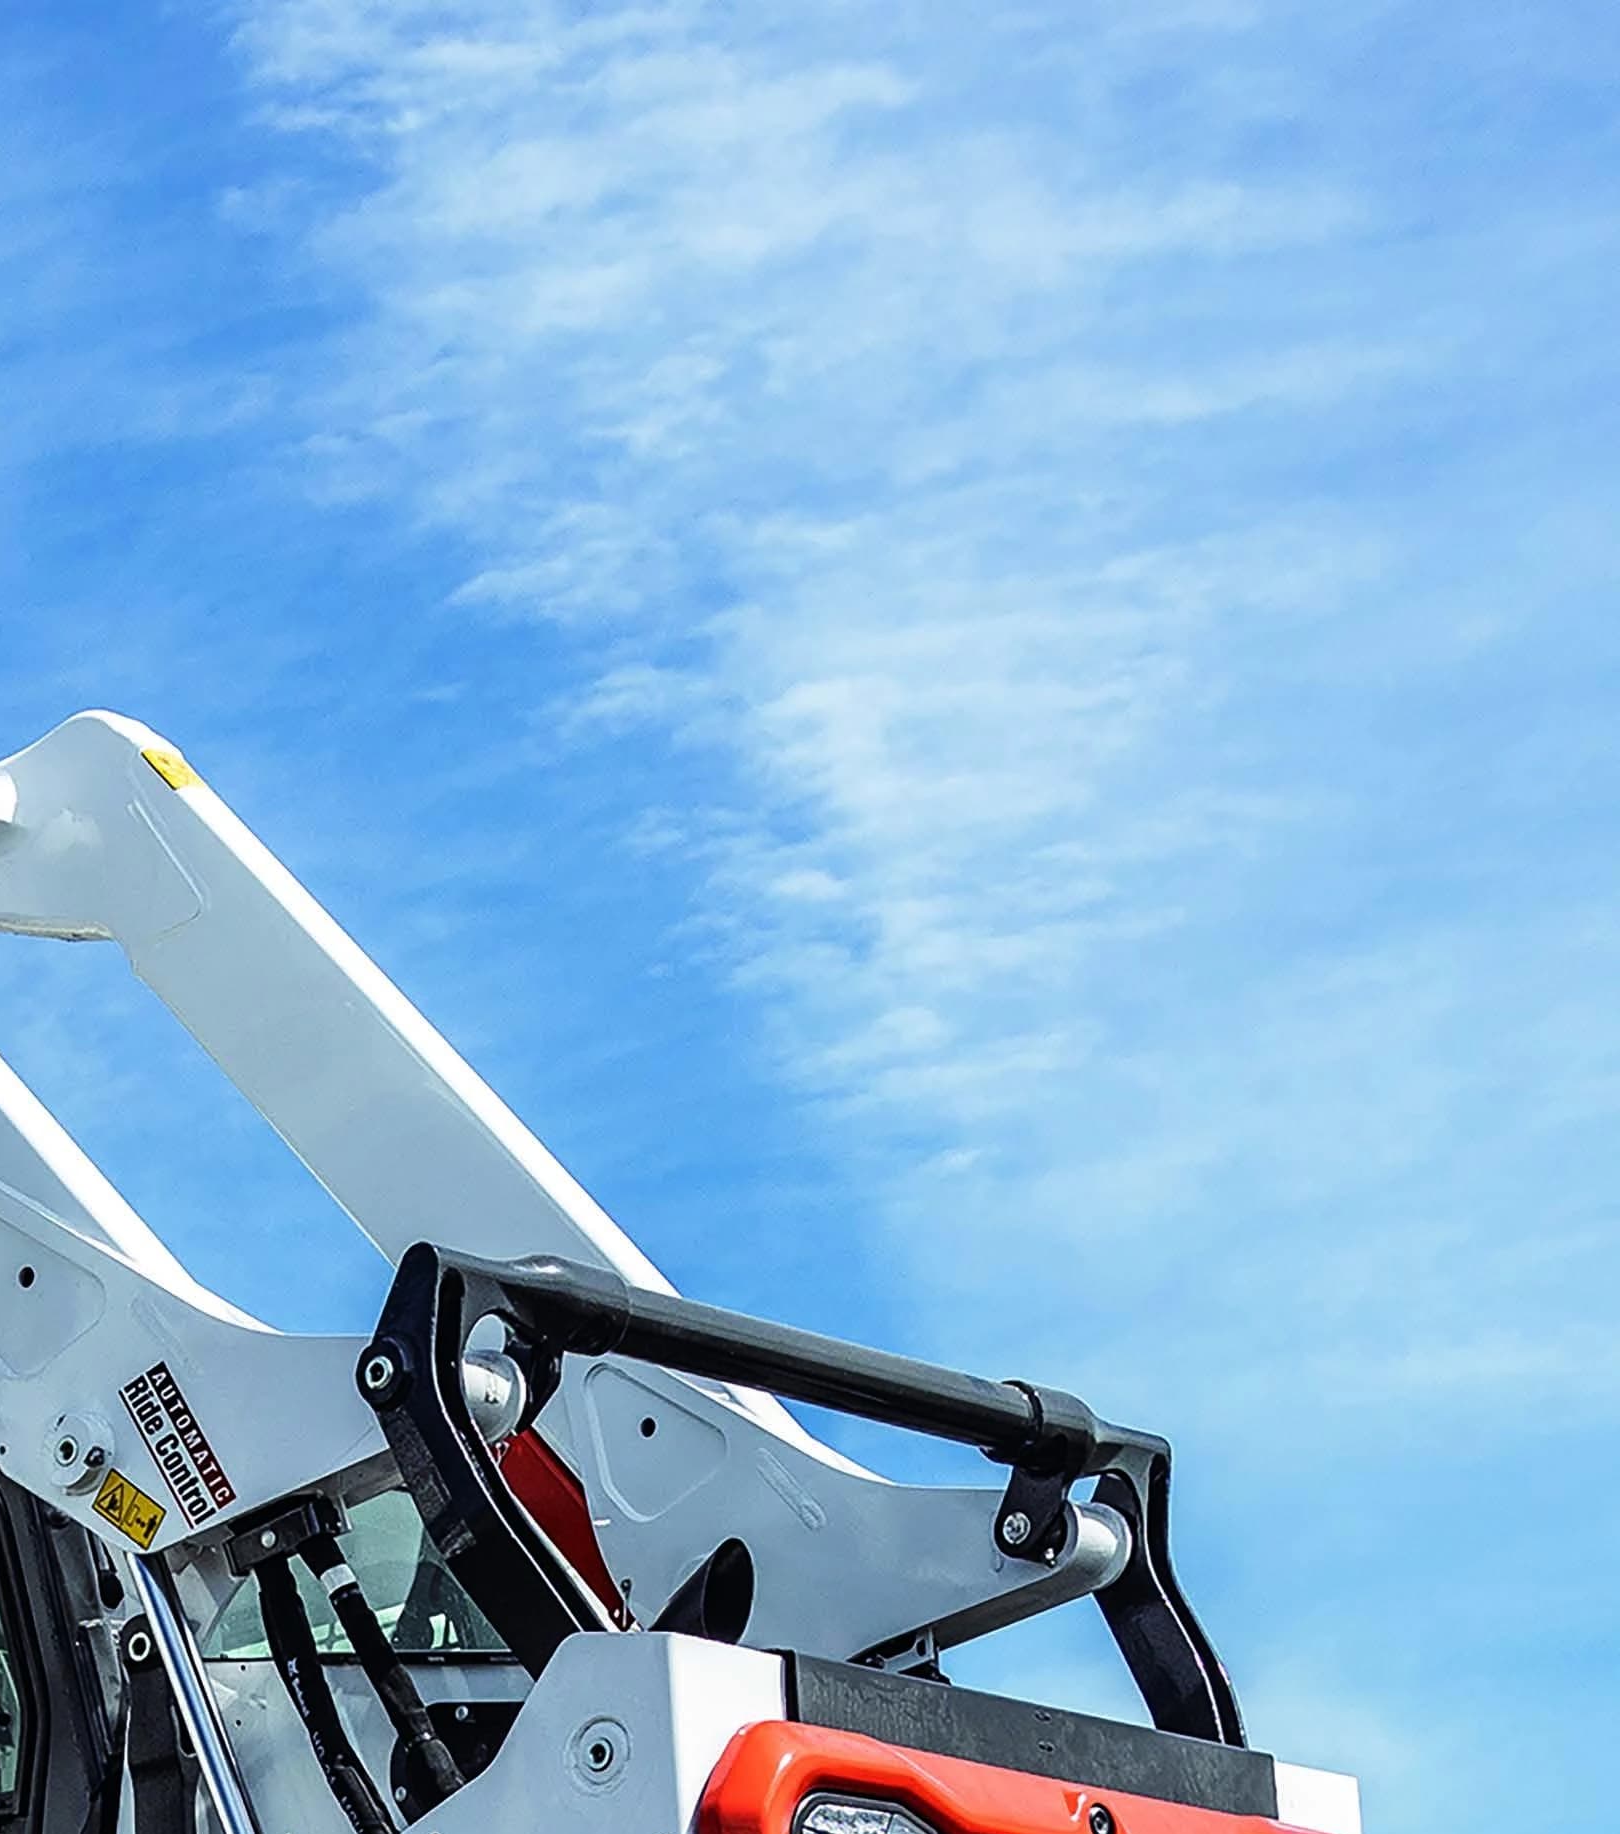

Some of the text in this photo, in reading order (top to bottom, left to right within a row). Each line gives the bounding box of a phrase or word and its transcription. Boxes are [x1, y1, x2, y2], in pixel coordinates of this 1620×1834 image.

[123, 1375, 216, 1525] Ride Control
[151, 1371, 231, 1502] AUTOMATIC
